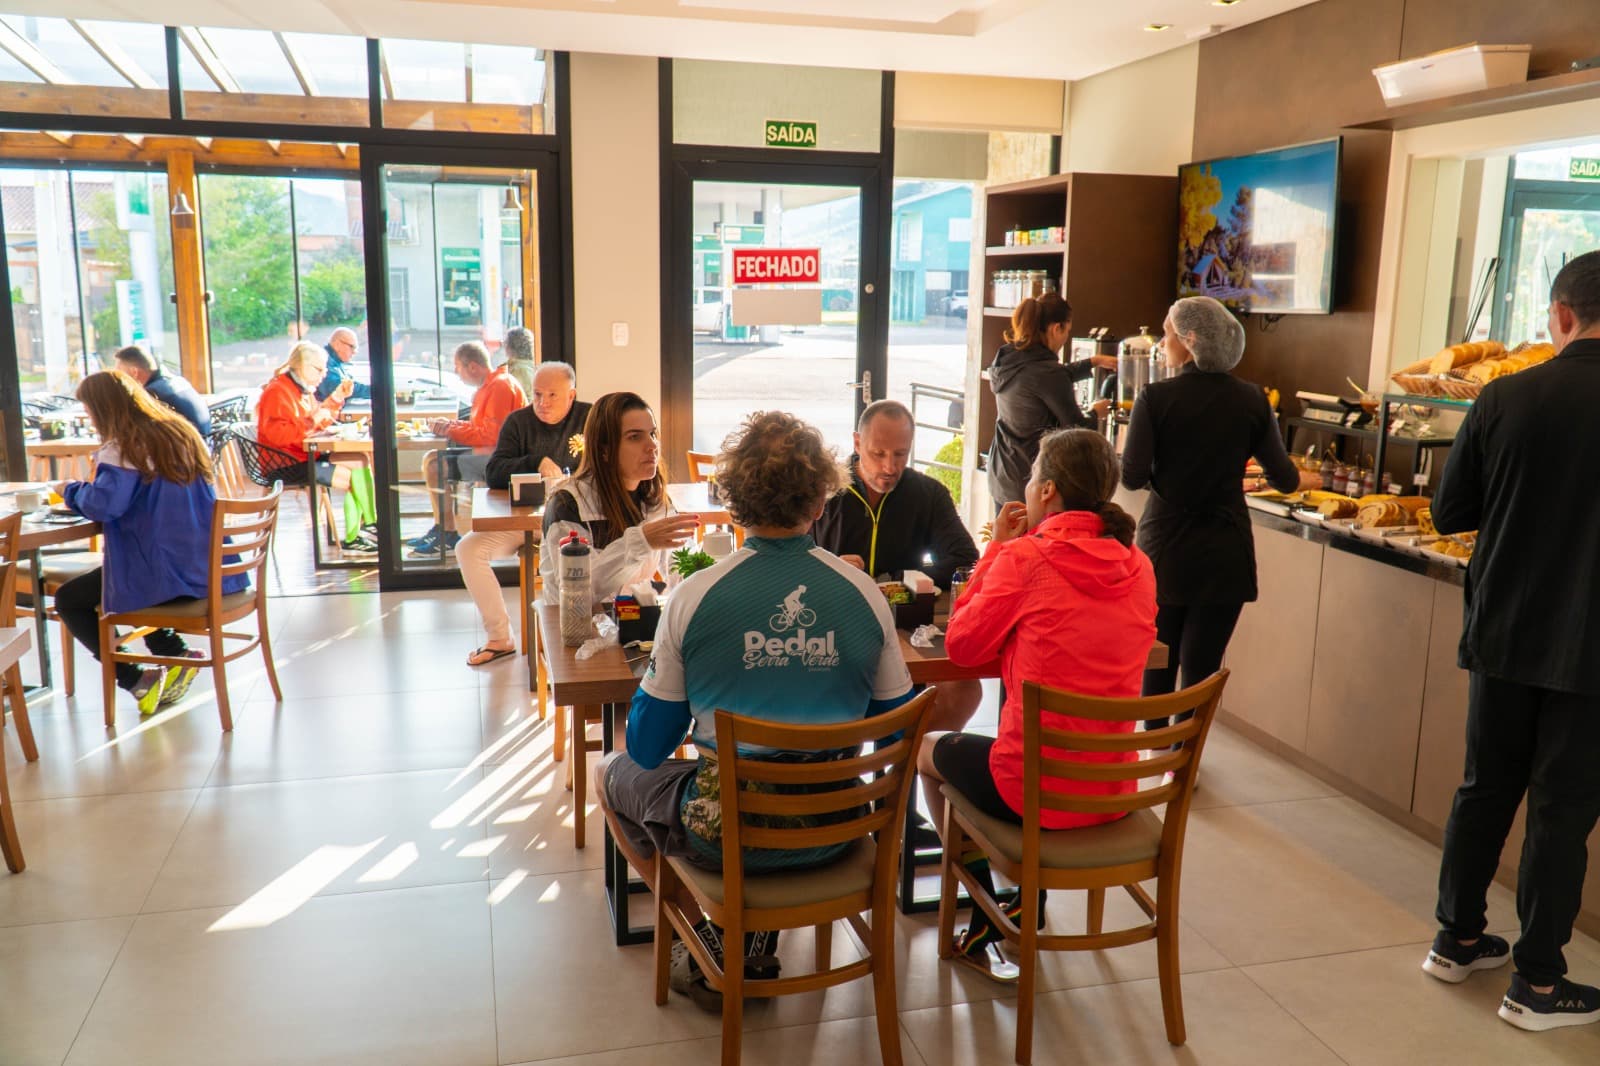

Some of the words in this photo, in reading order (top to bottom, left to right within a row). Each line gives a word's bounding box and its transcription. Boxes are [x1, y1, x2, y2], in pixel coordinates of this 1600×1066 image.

[767, 123, 816, 143] SAÍDA
[736, 255, 817, 278] FECHADO
[744, 629, 835, 656] Pedal
[743, 649, 790, 670] Serra
[791, 645, 840, 667] Verde
